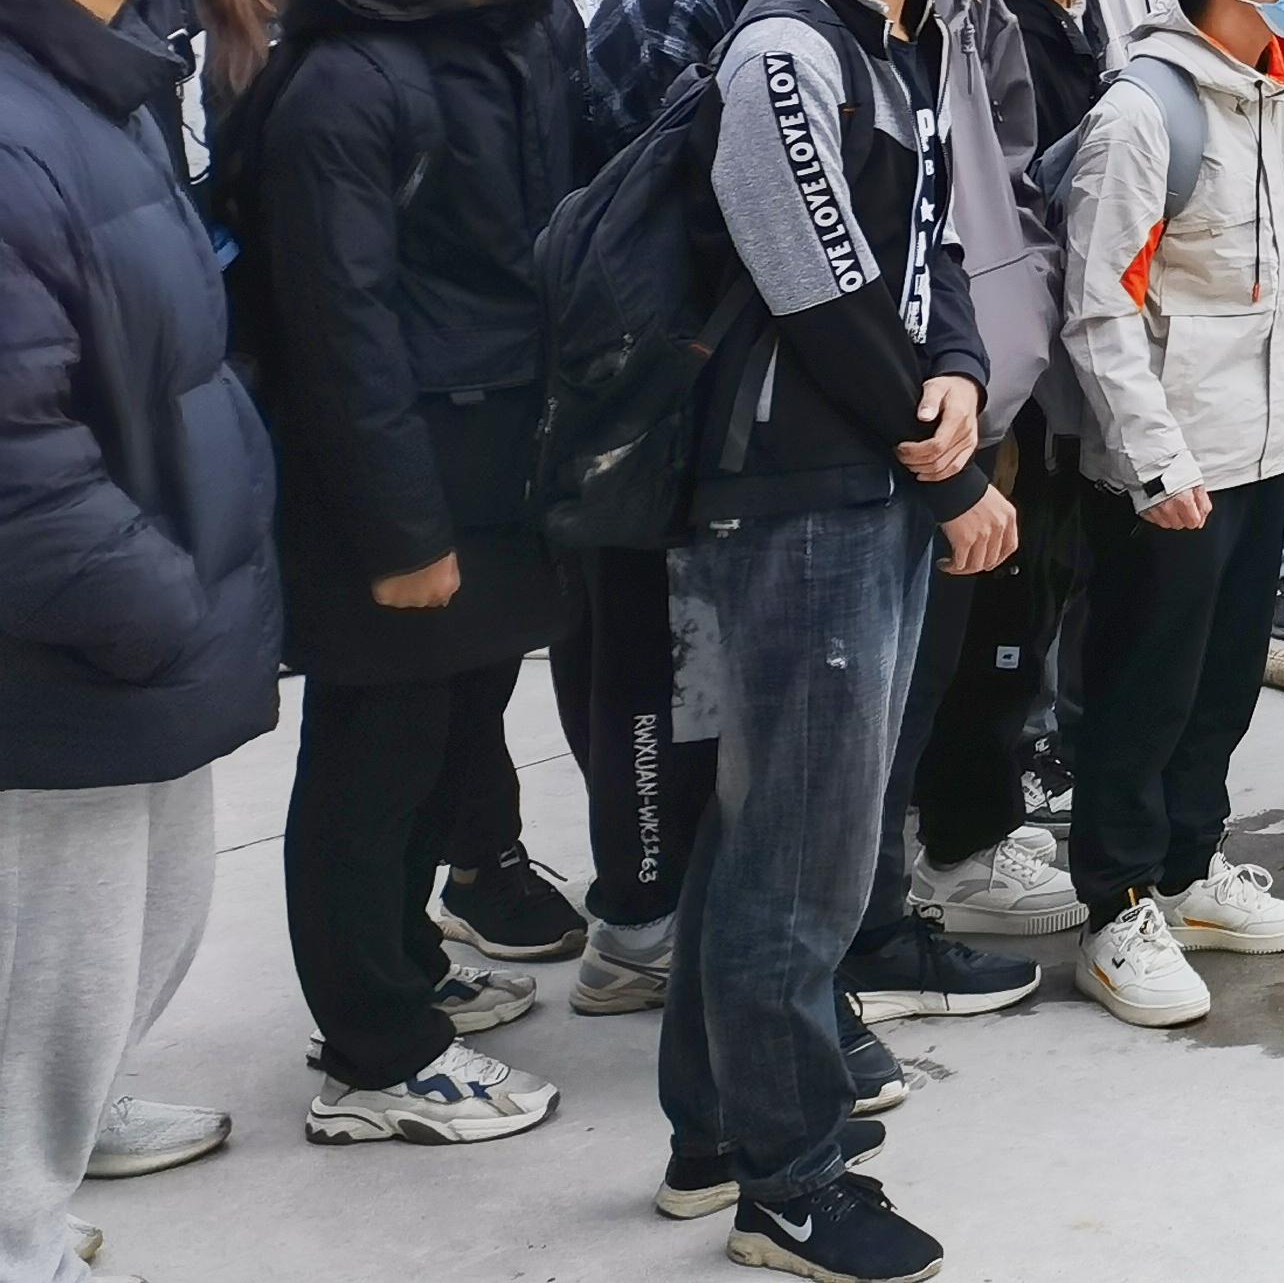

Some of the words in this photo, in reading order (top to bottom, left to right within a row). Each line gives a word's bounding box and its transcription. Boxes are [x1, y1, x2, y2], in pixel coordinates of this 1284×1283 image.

[765, 52, 800, 108] LOV
[779, 111, 820, 176] LOVE
[801, 178, 846, 241] LOVE
